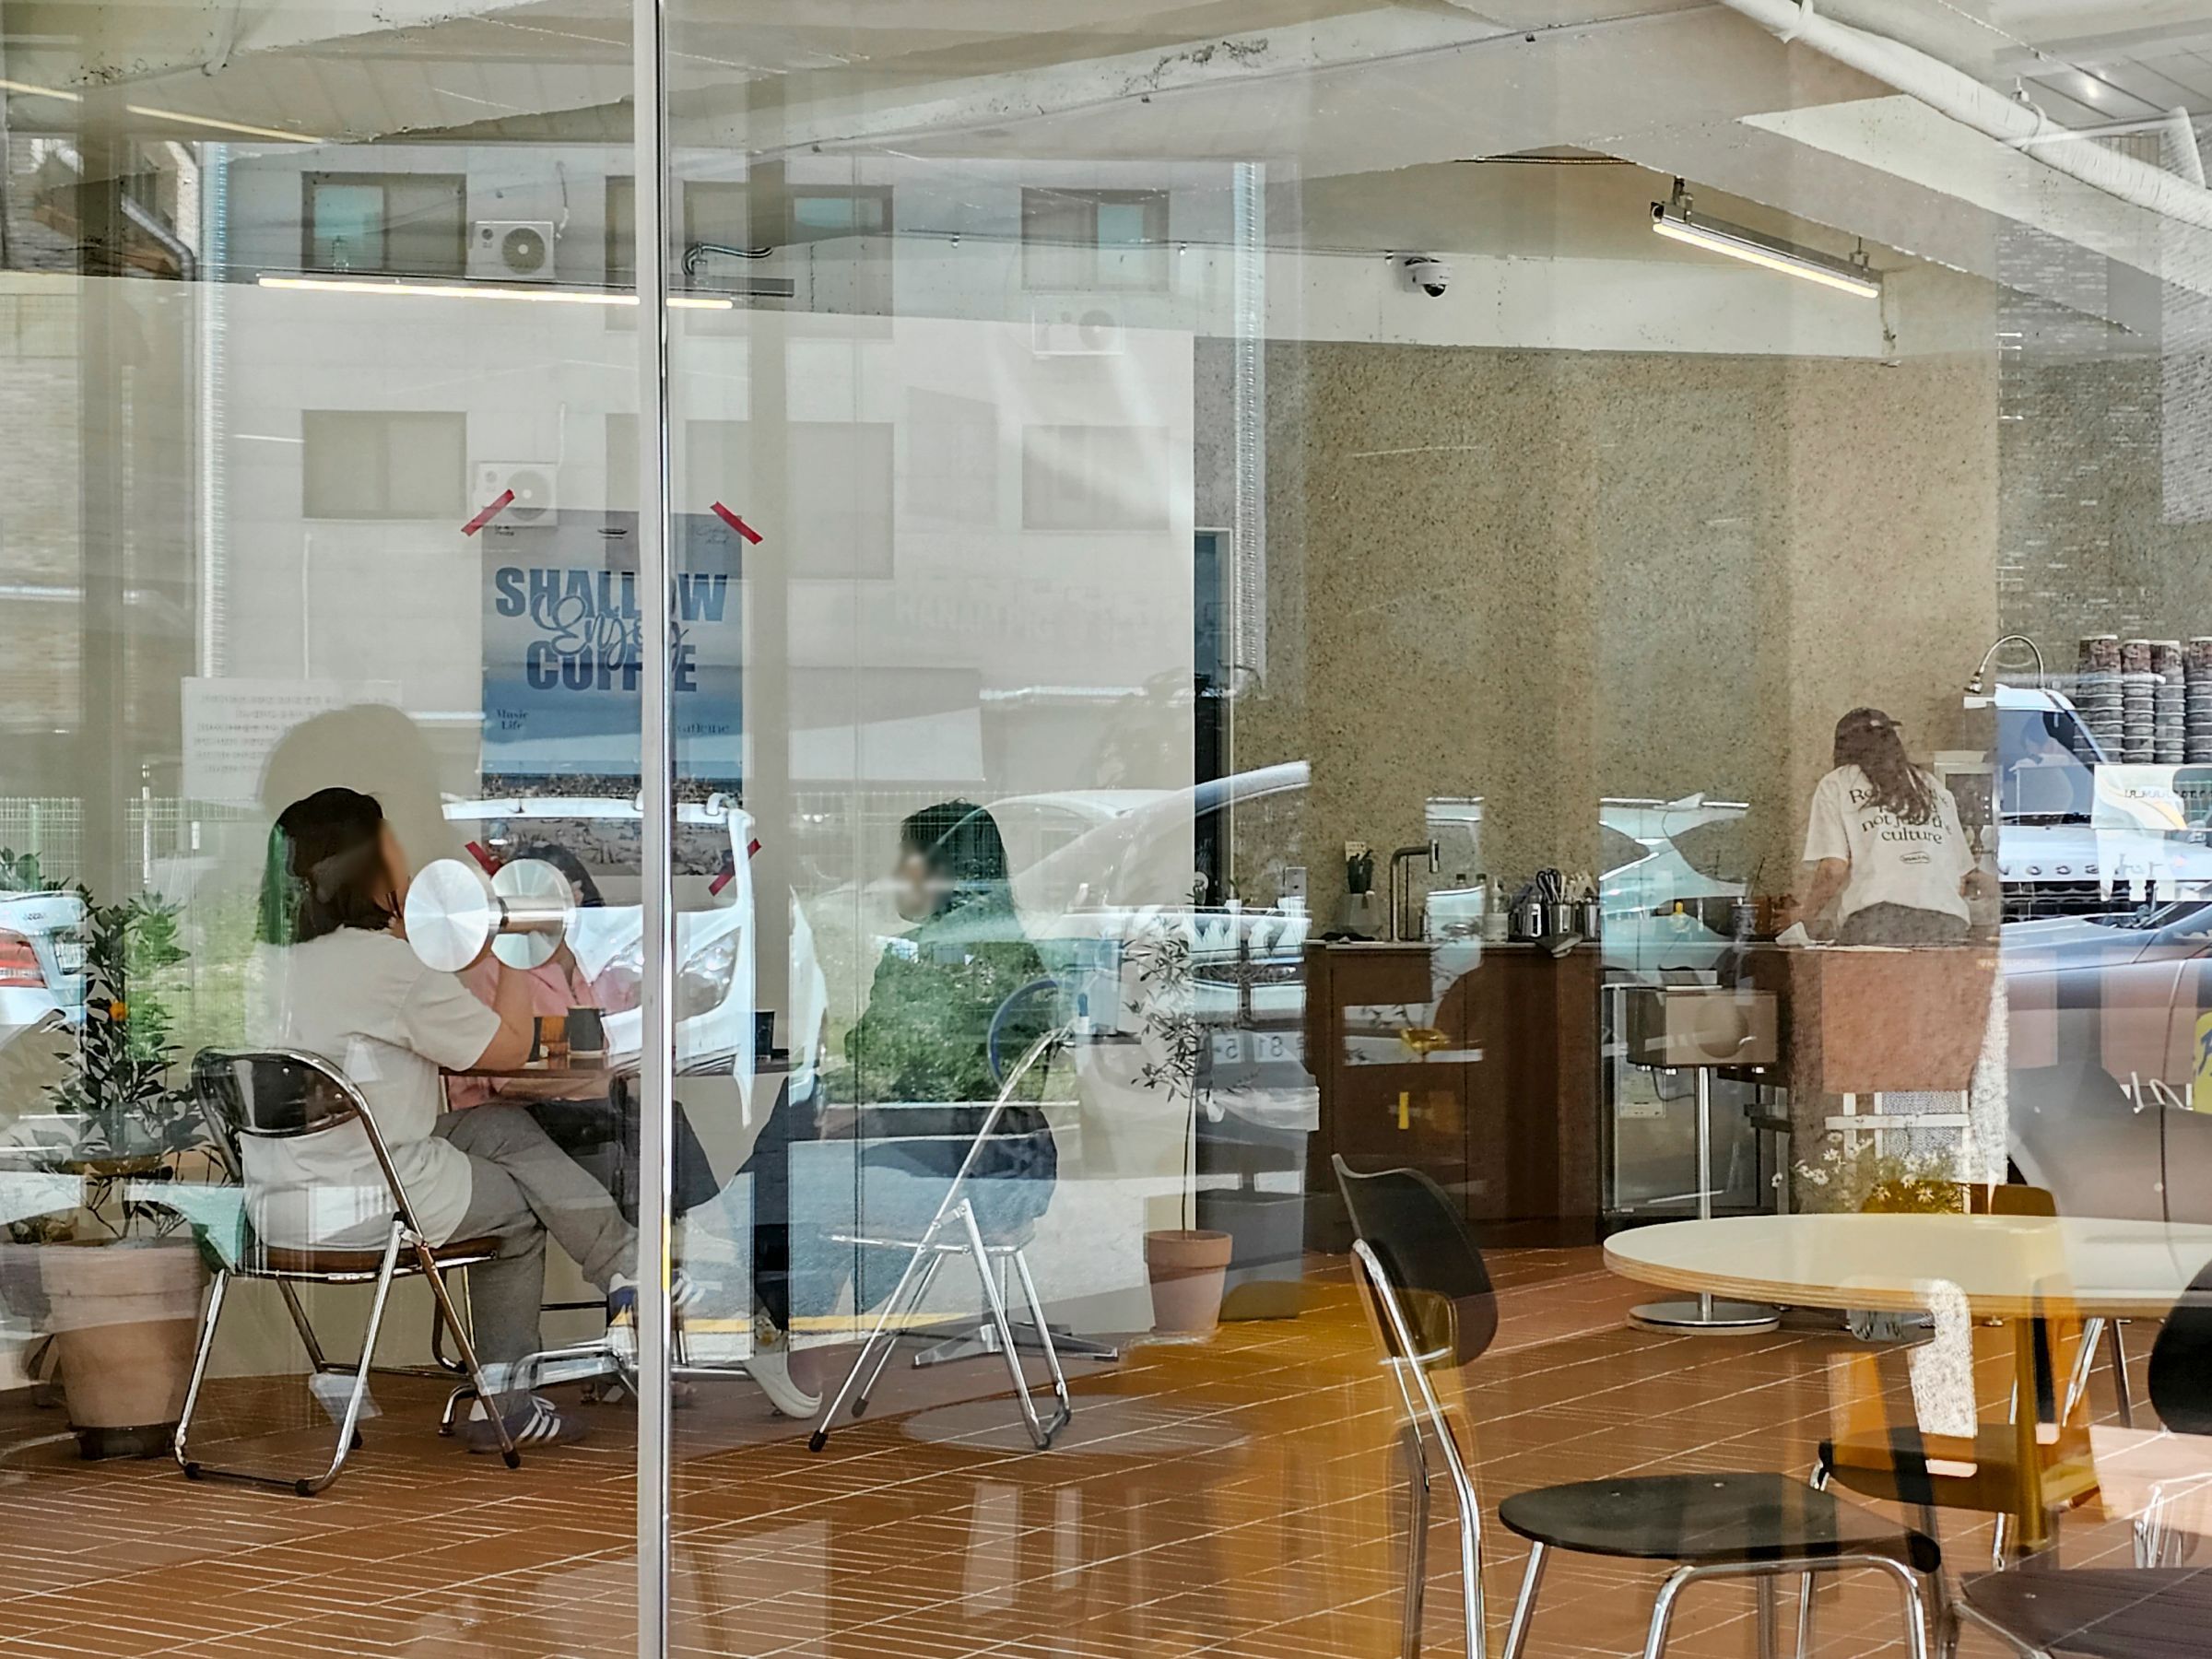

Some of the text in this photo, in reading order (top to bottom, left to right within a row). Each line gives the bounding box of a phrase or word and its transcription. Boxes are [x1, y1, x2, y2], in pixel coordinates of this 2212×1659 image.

[495, 567, 728, 622] SHALLW
[526, 641, 698, 693] COFFE
[1862, 814, 1892, 832] not
[1881, 828, 1943, 844] culture
